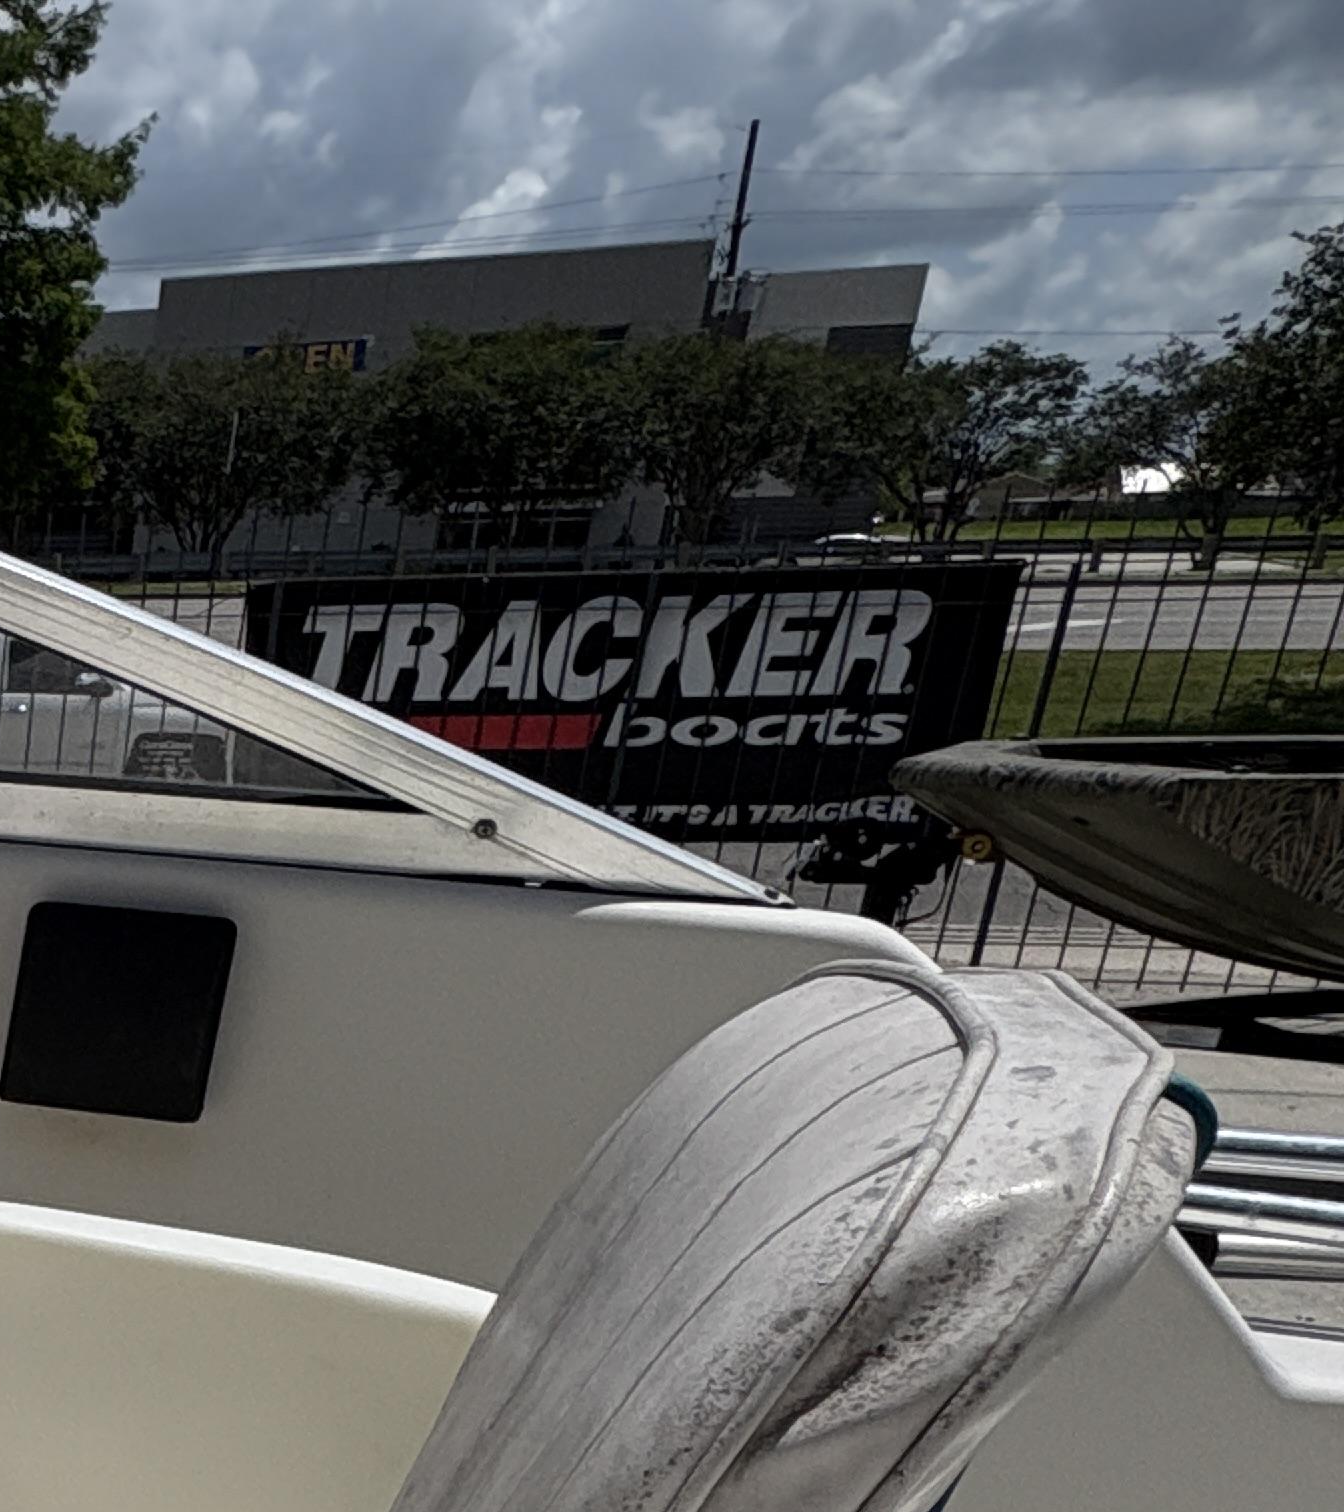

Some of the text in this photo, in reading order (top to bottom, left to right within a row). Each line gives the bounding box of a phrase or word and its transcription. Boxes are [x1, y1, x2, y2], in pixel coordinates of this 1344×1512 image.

[302, 588, 933, 701] TRACKER
[605, 703, 909, 747] boats
[711, 804, 738, 827] A
